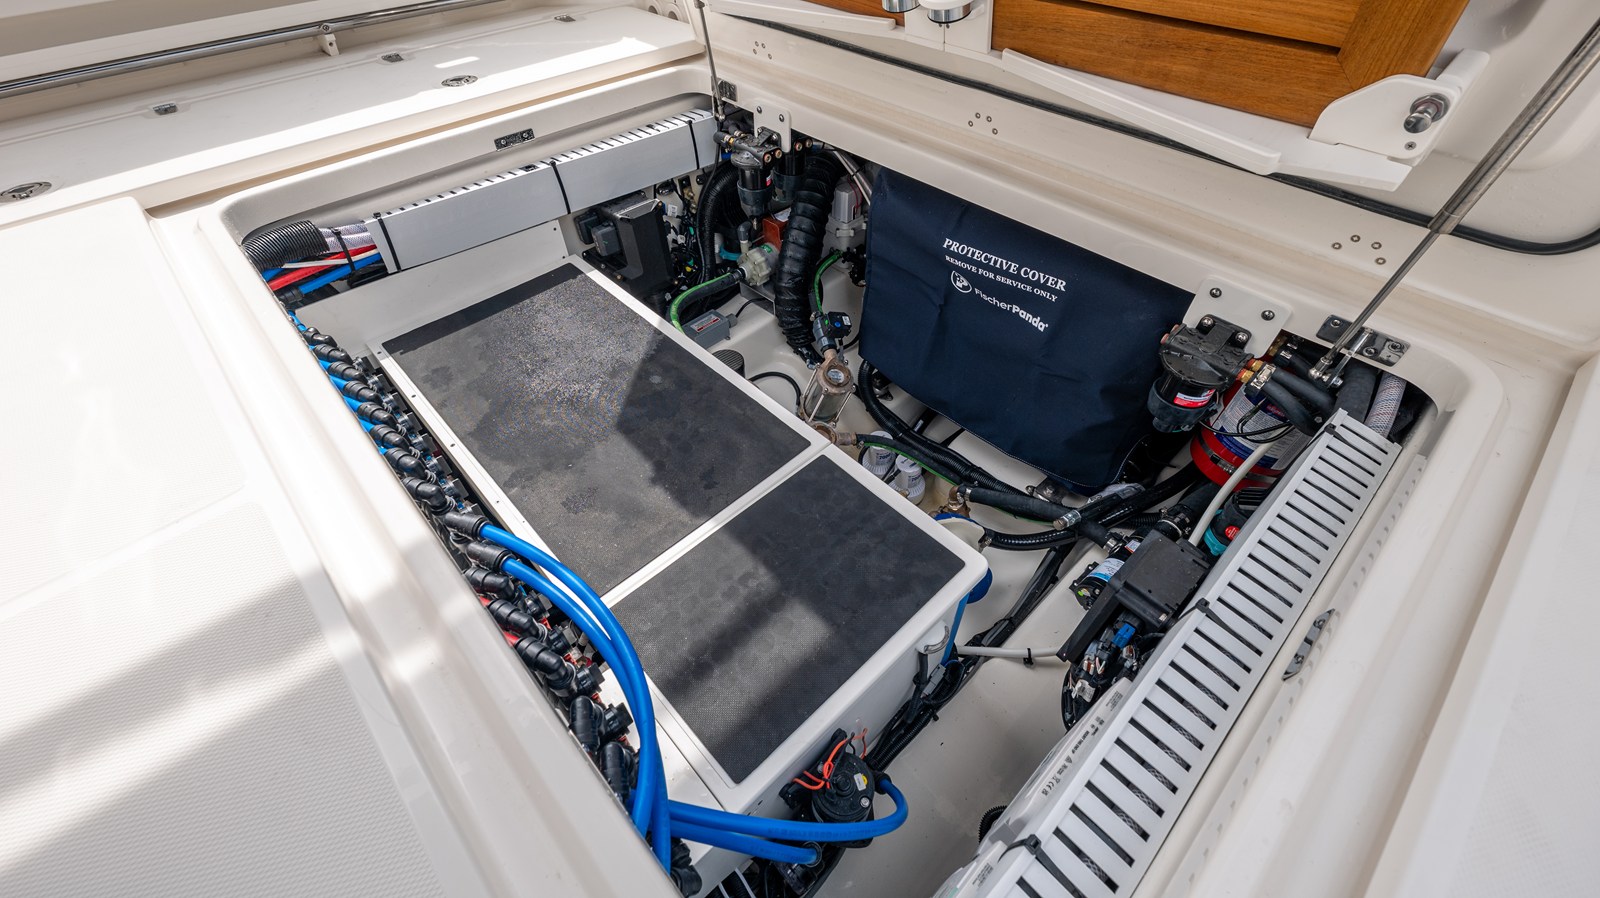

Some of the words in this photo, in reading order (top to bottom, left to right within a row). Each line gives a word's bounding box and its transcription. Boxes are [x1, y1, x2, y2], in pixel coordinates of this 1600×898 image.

[943, 238, 1019, 274] PROTECTIVE
[1020, 267, 1067, 291] COVER
[945, 255, 977, 273] REMOVE
[978, 268, 995, 280] FOR
[996, 275, 1032, 292] SERVICE
[1034, 288, 1058, 302] ONLY
